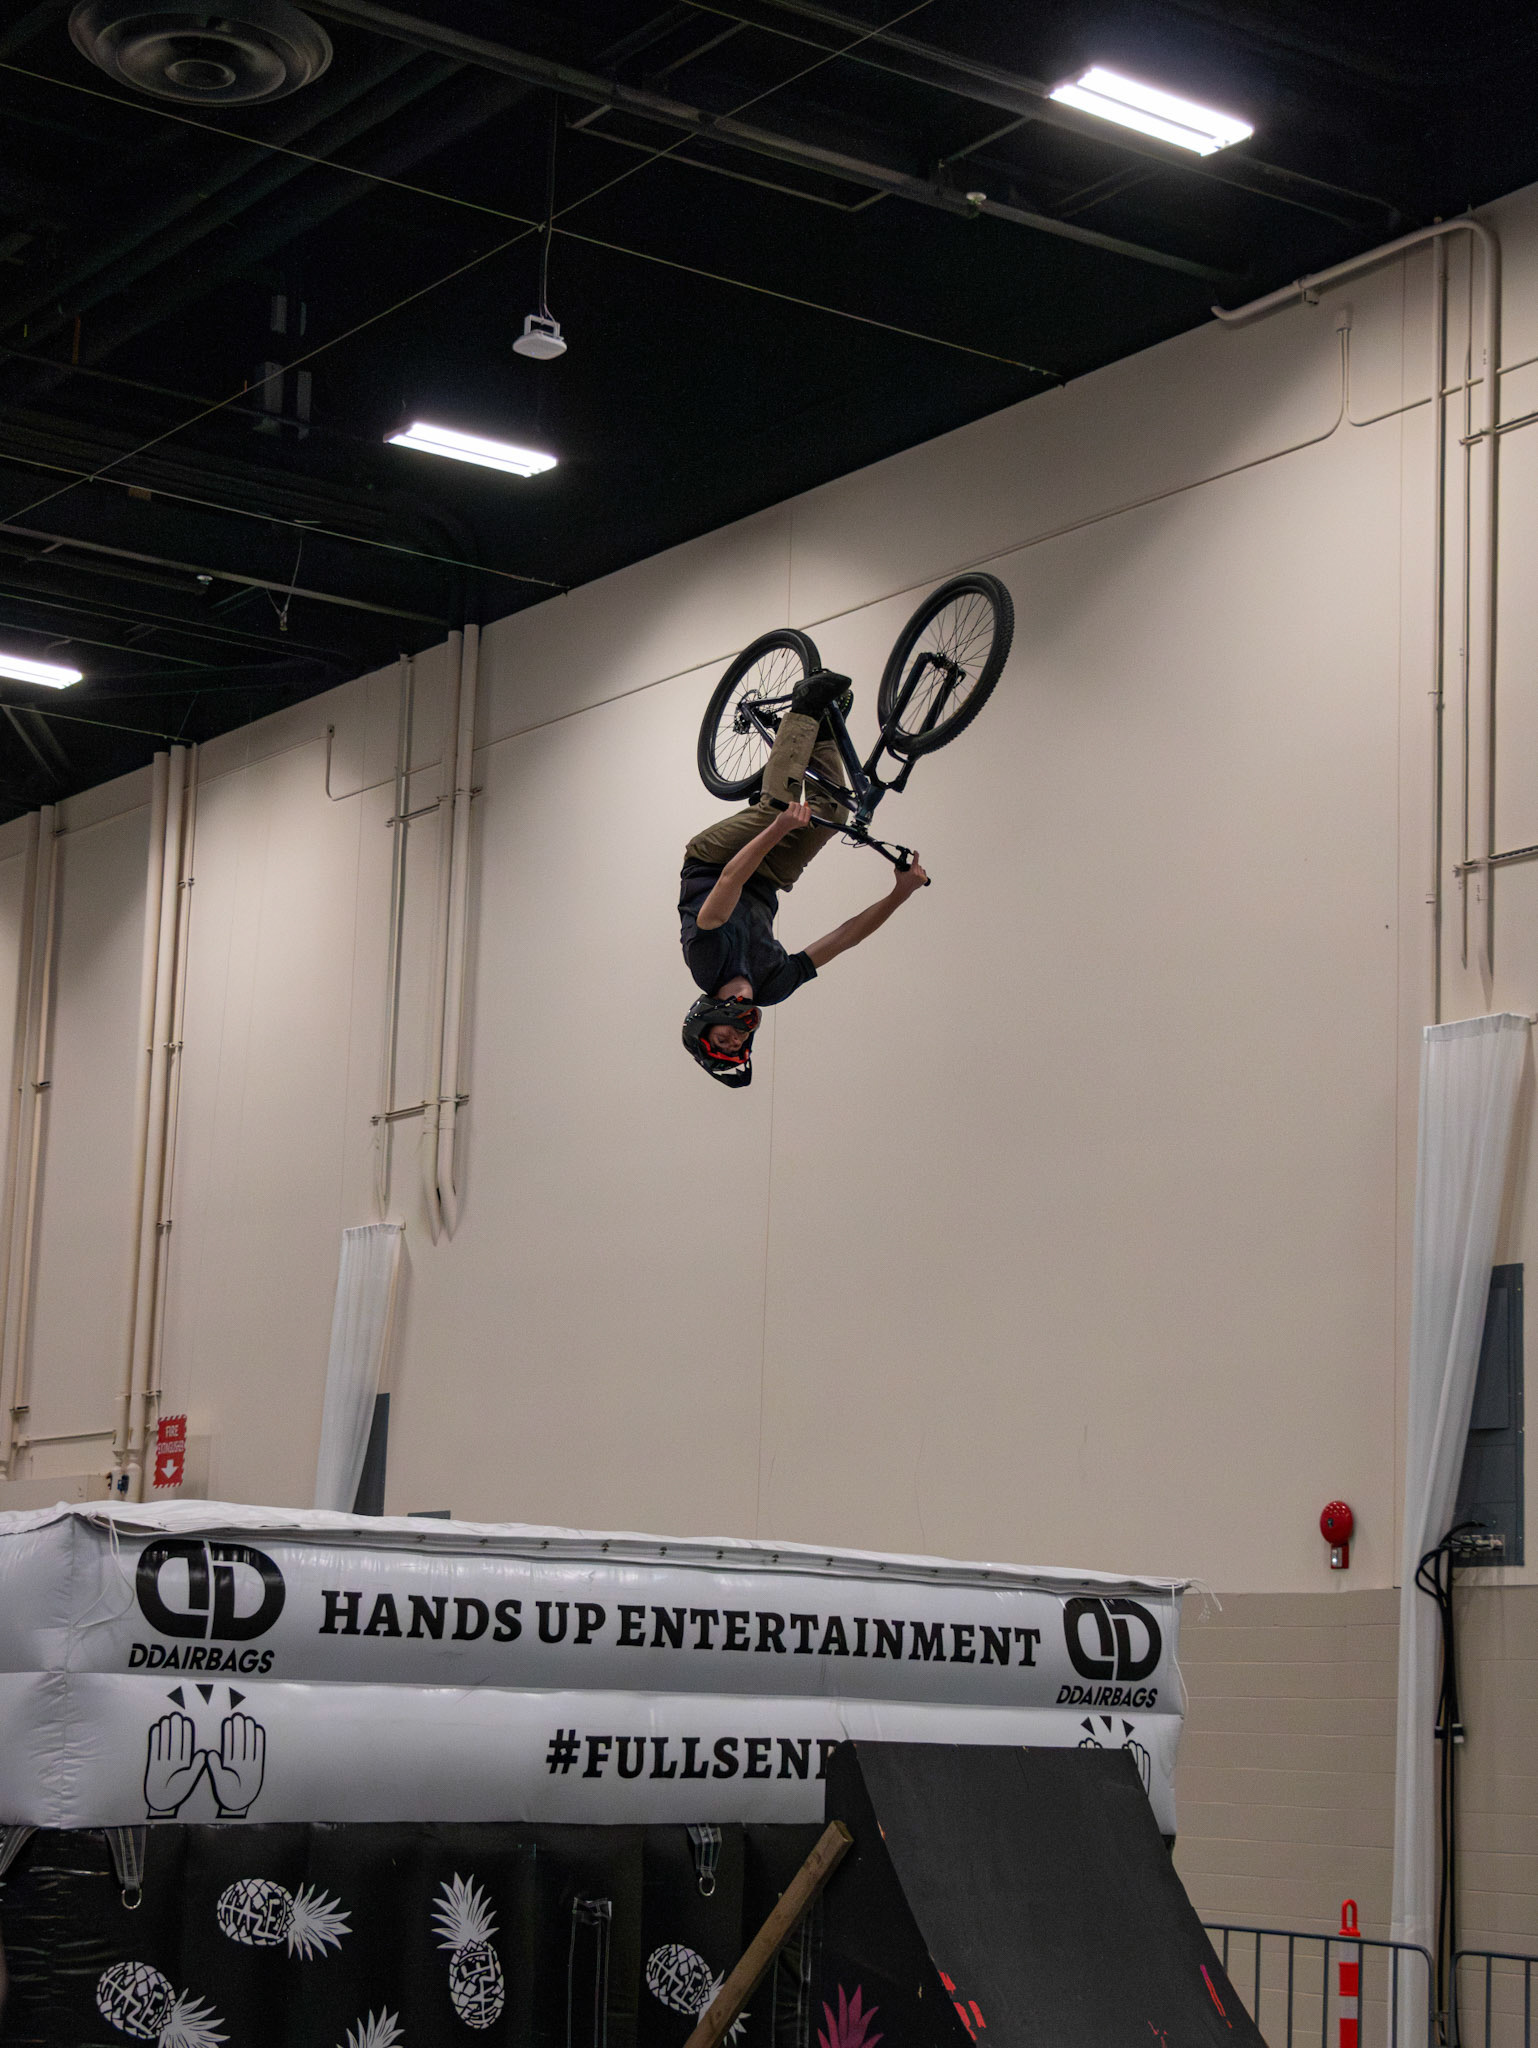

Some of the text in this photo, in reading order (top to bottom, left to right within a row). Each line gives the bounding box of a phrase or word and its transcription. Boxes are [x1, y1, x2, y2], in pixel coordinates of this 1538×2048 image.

[165, 1424, 180, 1438] FIRE
[319, 1590, 1041, 1667] HANDS UP ENTERTAINMENT
[128, 1643, 275, 1674] DDAIRBAGS
[1056, 1685, 1158, 1708] DDAIRBAGS
